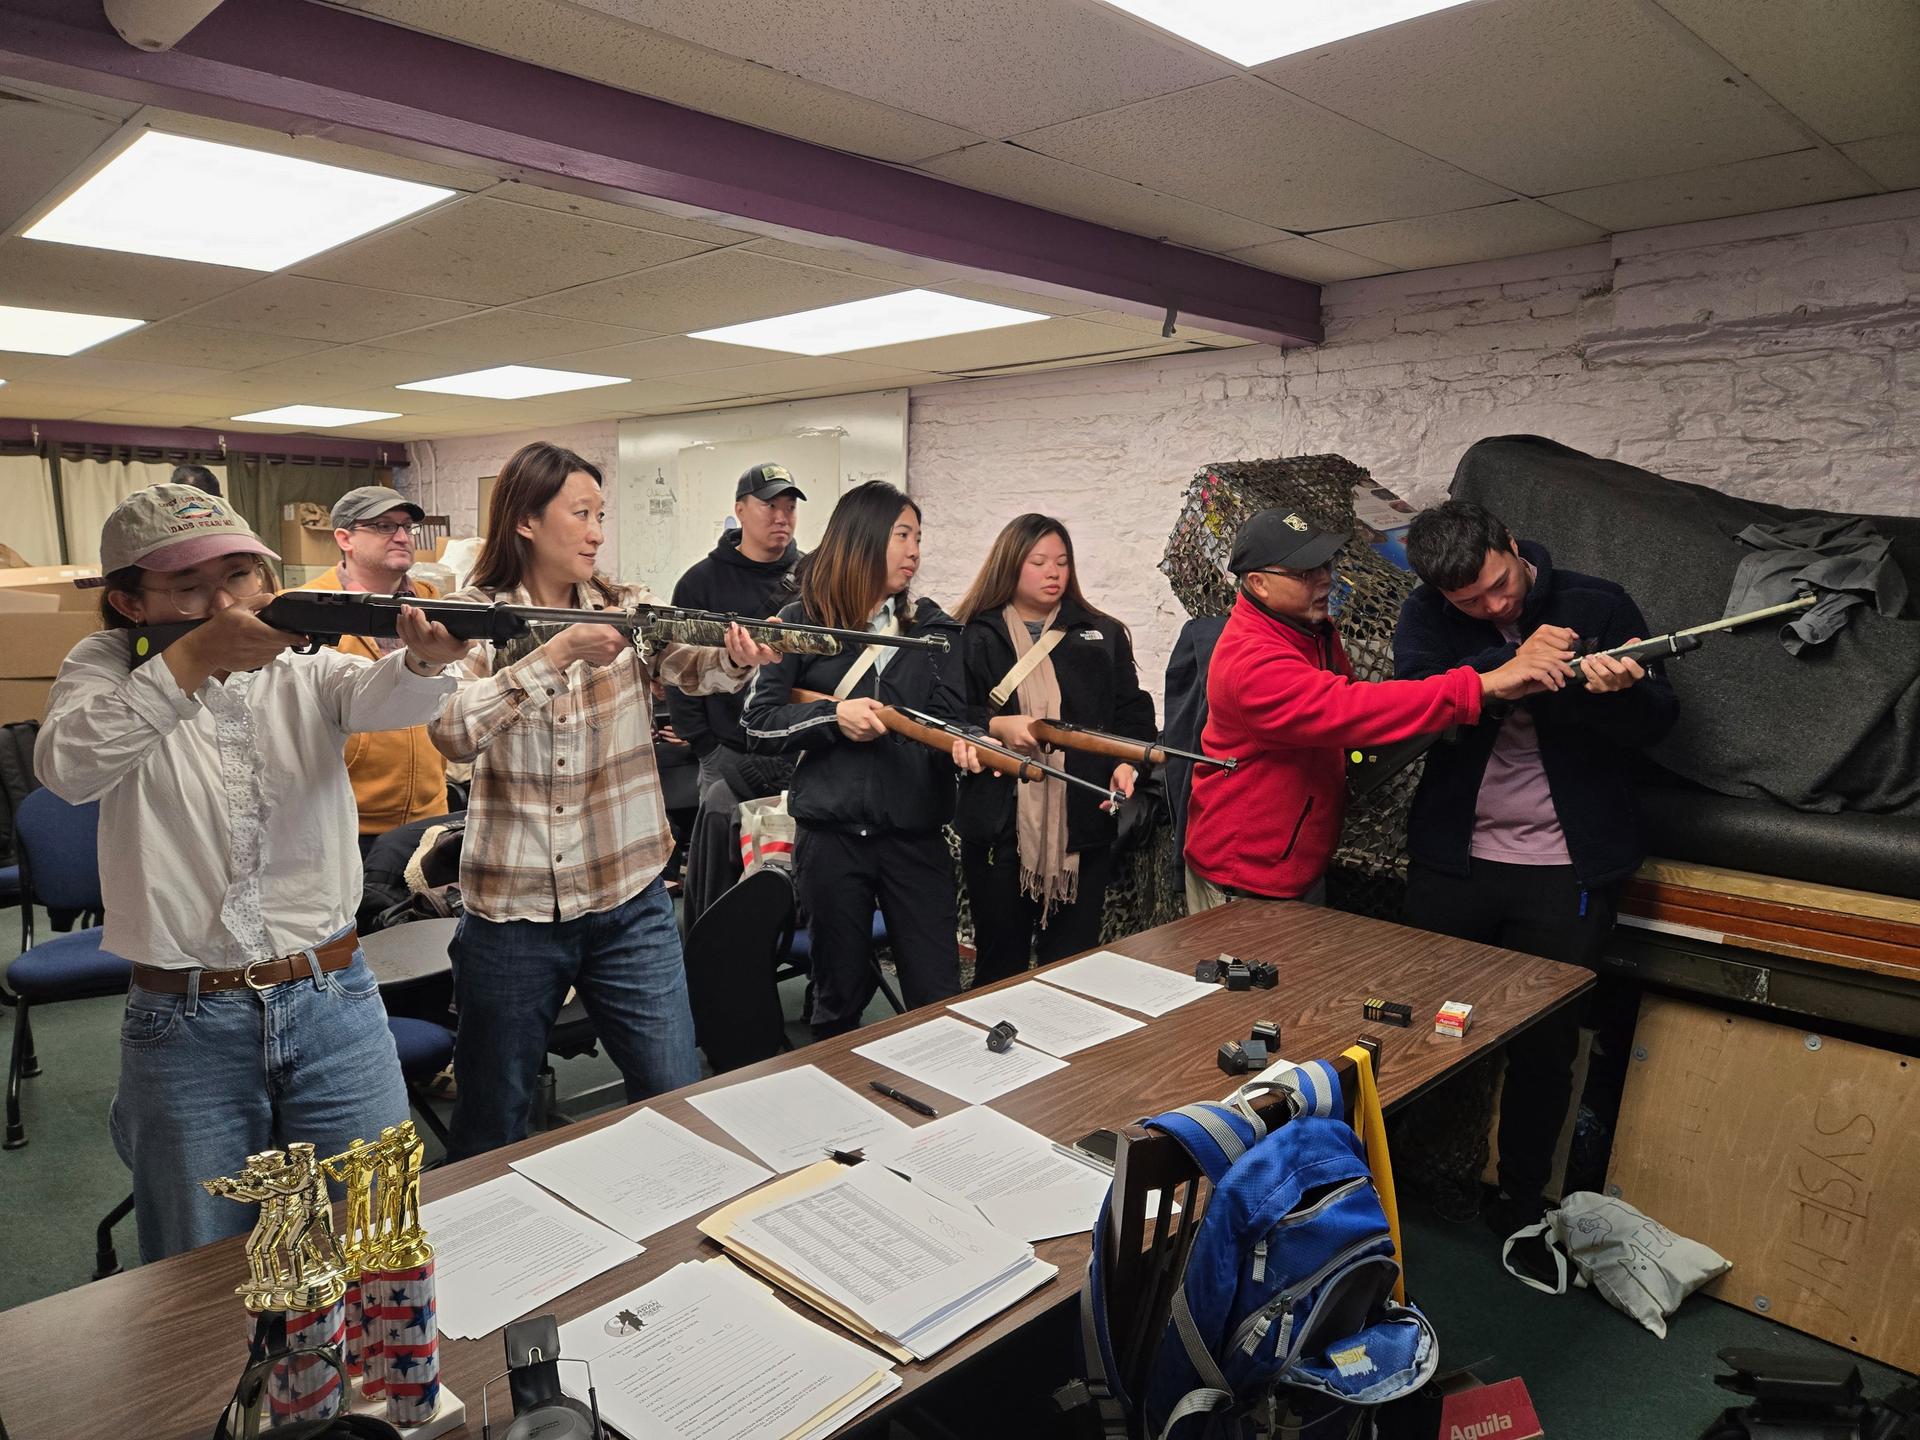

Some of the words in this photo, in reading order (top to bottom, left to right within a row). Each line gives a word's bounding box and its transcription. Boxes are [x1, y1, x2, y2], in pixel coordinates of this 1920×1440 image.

[170, 522, 195, 533] DADS
[198, 519, 222, 527] FEAR
[1450, 1413, 1513, 1440] Aguila
